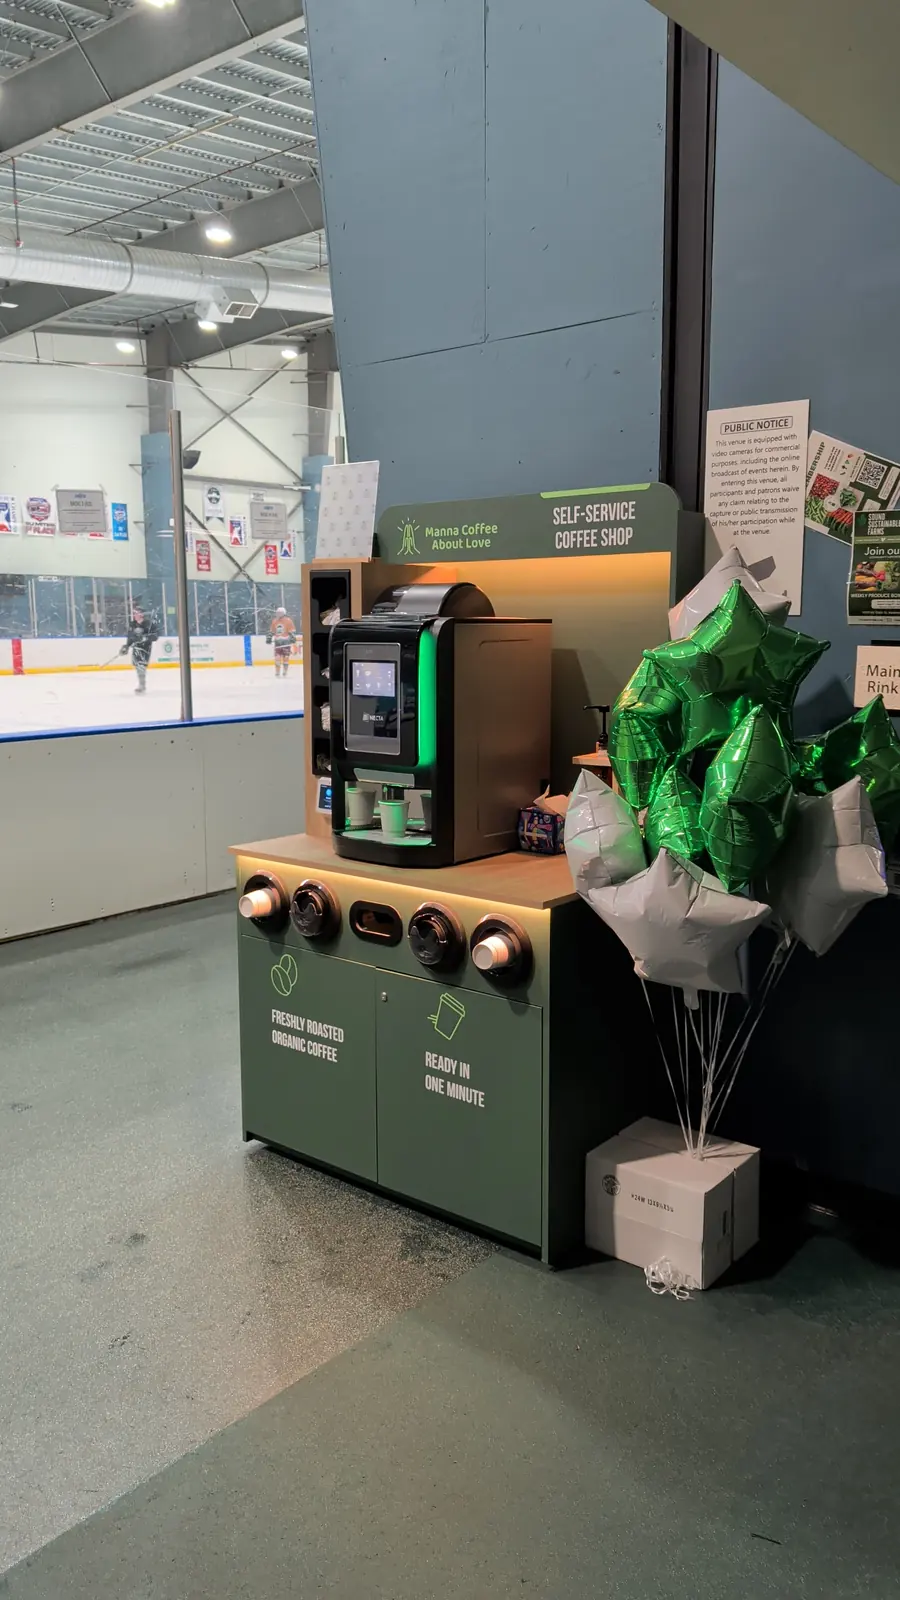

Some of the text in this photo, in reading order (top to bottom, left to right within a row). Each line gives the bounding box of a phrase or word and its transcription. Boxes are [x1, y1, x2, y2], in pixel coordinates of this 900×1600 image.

[724, 419, 788, 432] PUBLIC NOTICE
[754, 434, 782, 443] equipped
[765, 444, 800, 452] commercial
[806, 442, 825, 487] MBERSHIP
[711, 469, 739, 477] broadcast
[710, 489, 743, 498] participants
[757, 487, 780, 495] patrons
[553, 501, 636, 525] SELF-SERVICE
[425, 523, 498, 537] Manna Coffee
[432, 537, 491, 550] About Love
[555, 527, 633, 549] COFFEE SHOP
[864, 547, 885, 555] Join
[866, 664, 900, 678] Main
[868, 680, 898, 694] Rink
[272, 1009, 344, 1042] FRESHLY ROASTED
[272, 1030, 337, 1062] ORGANIC COFFEE
[426, 1051, 470, 1079] READY IN
[425, 1074, 484, 1107] ONE MINUTE
